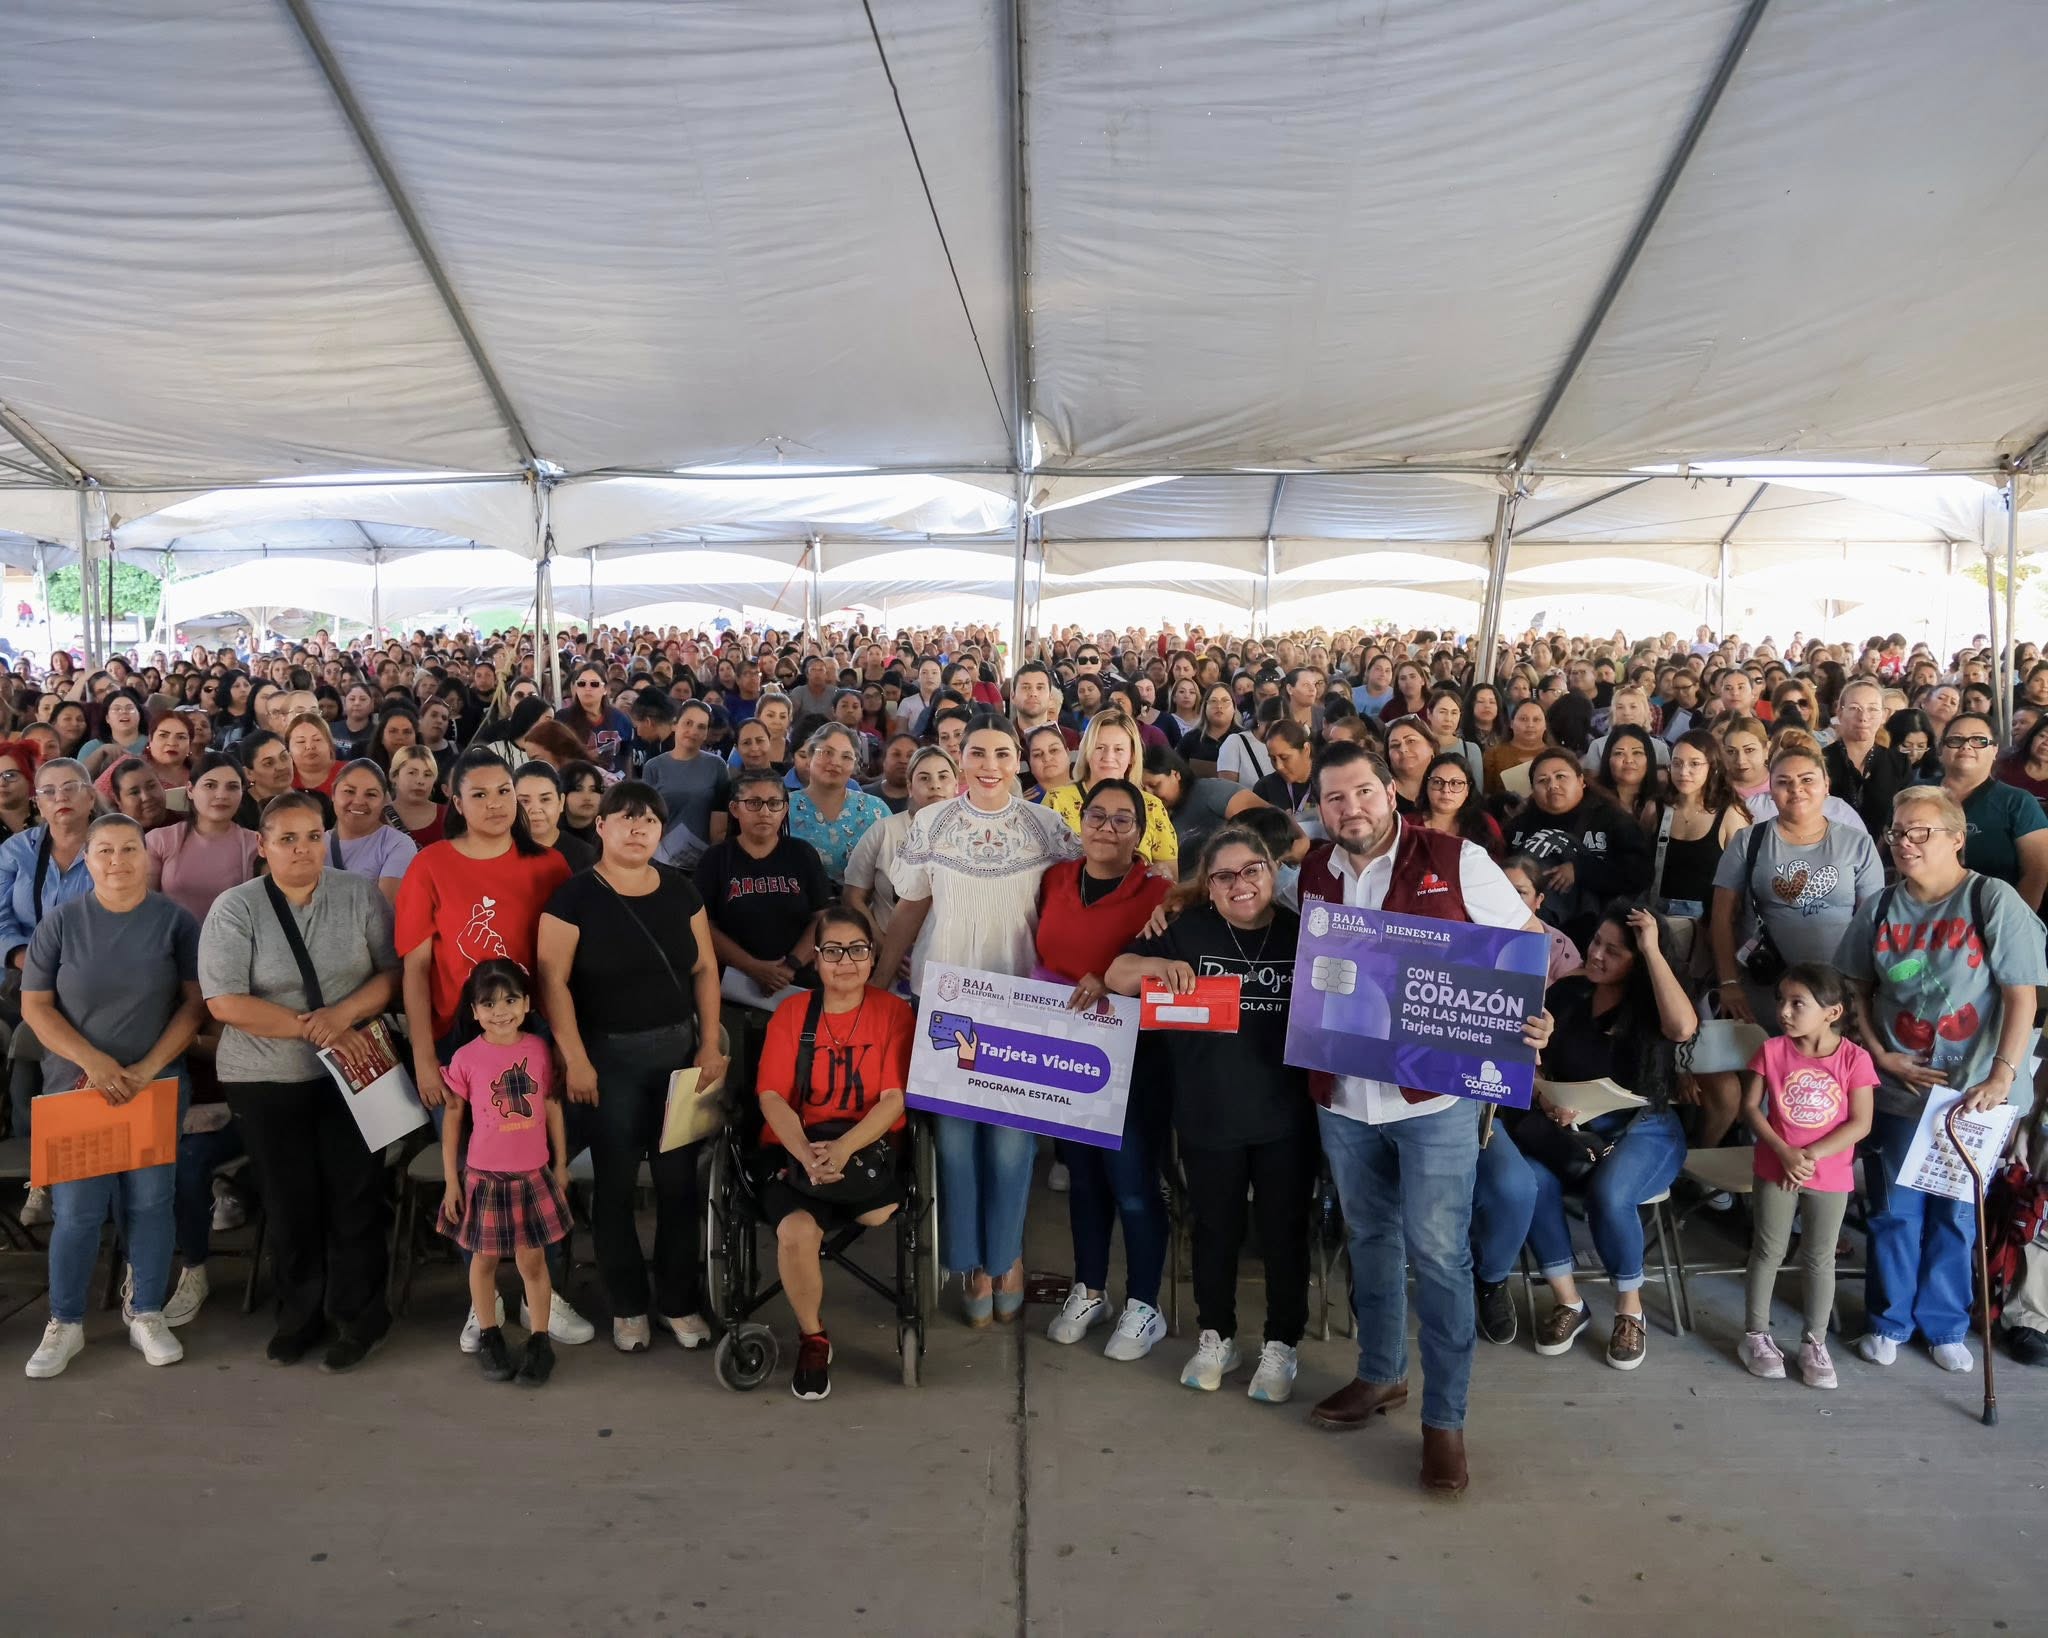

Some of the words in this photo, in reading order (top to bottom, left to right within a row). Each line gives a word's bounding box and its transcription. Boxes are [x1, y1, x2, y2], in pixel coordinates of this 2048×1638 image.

[728, 876, 800, 901] ANGELS
[1332, 912, 1365, 926] BAJA
[1331, 923, 1377, 935] CALIFORNIA
[1385, 924, 1451, 942] BIENESTAR
[1406, 967, 1435, 982] CON
[1437, 971, 1453, 985] EL
[962, 978, 993, 992] BAJA
[961, 987, 1005, 1001] CALIFORNIA
[1013, 991, 1069, 1009] BIENESTA
[1404, 980, 1524, 1018] CORAZÓN
[1240, 1002, 1273, 1011] OLAS
[1083, 1011, 1123, 1027] corazón
[1402, 1003, 1430, 1018] POR
[1433, 1007, 1458, 1022] LAS
[1460, 1012, 1522, 1033] MUJERES
[1400, 1018, 1443, 1036] Tarjeta
[1446, 1026, 1493, 1045] Violeta
[980, 1042, 1037, 1064] Tarjeta
[1041, 1053, 1101, 1077] Violeta
[1465, 1079, 1511, 1095] corazón
[1799, 1074, 1836, 1090] Best
[968, 1077, 1026, 1097] PROGRAMA
[1028, 1089, 1072, 1106] ESTATAL
[1783, 1085, 1833, 1108] Sister
[1791, 1106, 1824, 1121] Ever
[1955, 1120, 1985, 1132] OGRAMAS
